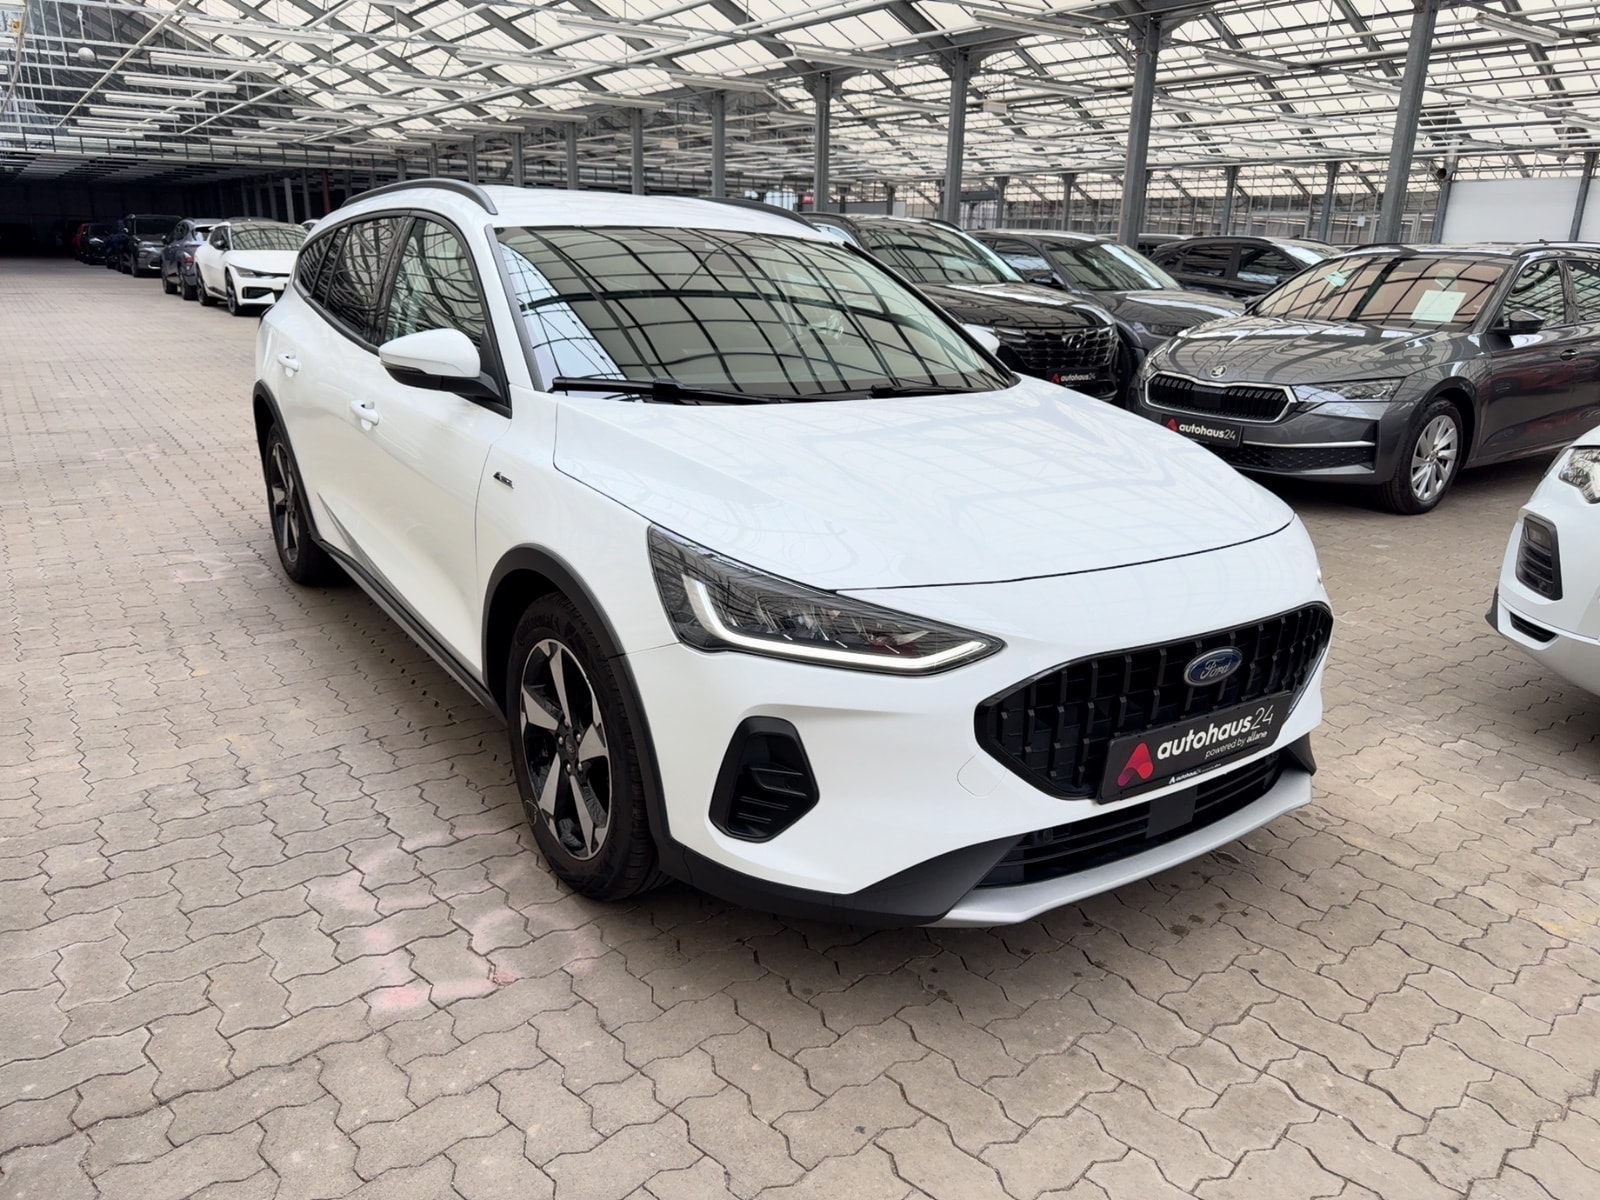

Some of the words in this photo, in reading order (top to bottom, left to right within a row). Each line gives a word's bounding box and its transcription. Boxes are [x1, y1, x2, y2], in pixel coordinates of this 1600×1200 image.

[1060, 372, 1097, 382] autohaus24
[1179, 423, 1237, 440] autohaus24
[1199, 658, 1231, 680] Ford
[1157, 705, 1274, 760] autohaus24
[1204, 738, 1237, 760] powered
[1237, 737, 1247, 747] by
[1246, 730, 1268, 743] allane
